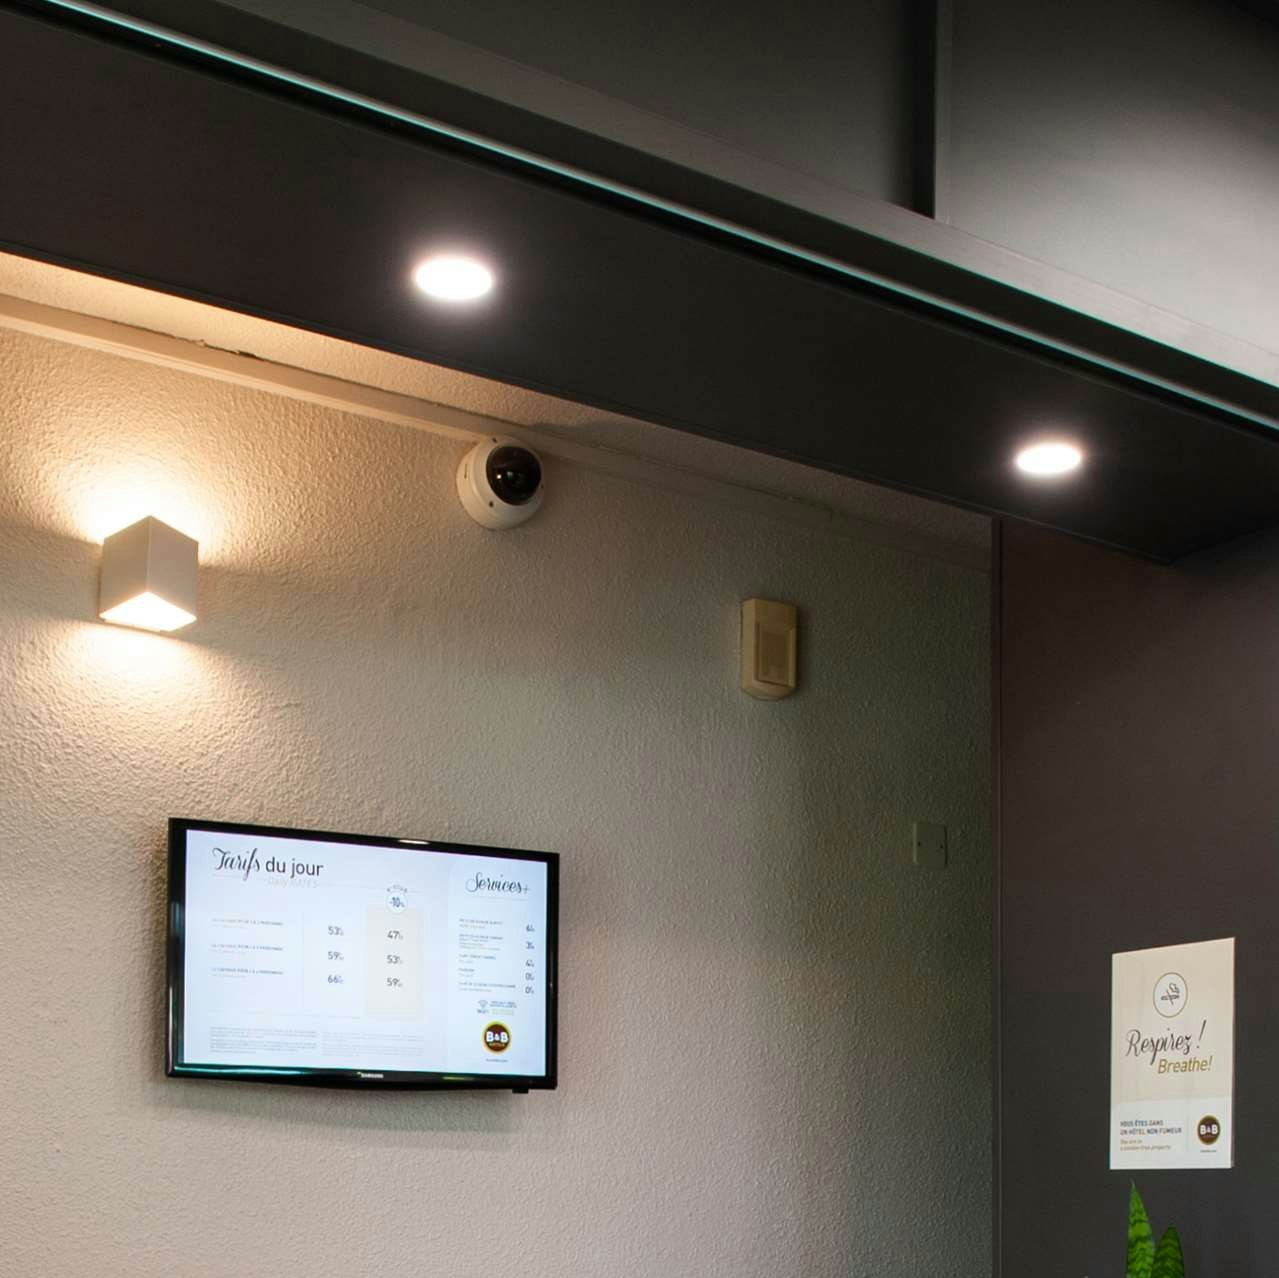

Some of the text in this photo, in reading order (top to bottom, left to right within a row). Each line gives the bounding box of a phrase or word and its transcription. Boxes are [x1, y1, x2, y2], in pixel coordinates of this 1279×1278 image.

[212, 847, 324, 881] Tarifs du jour
[1158, 1056, 1213, 1074] Breathe!
